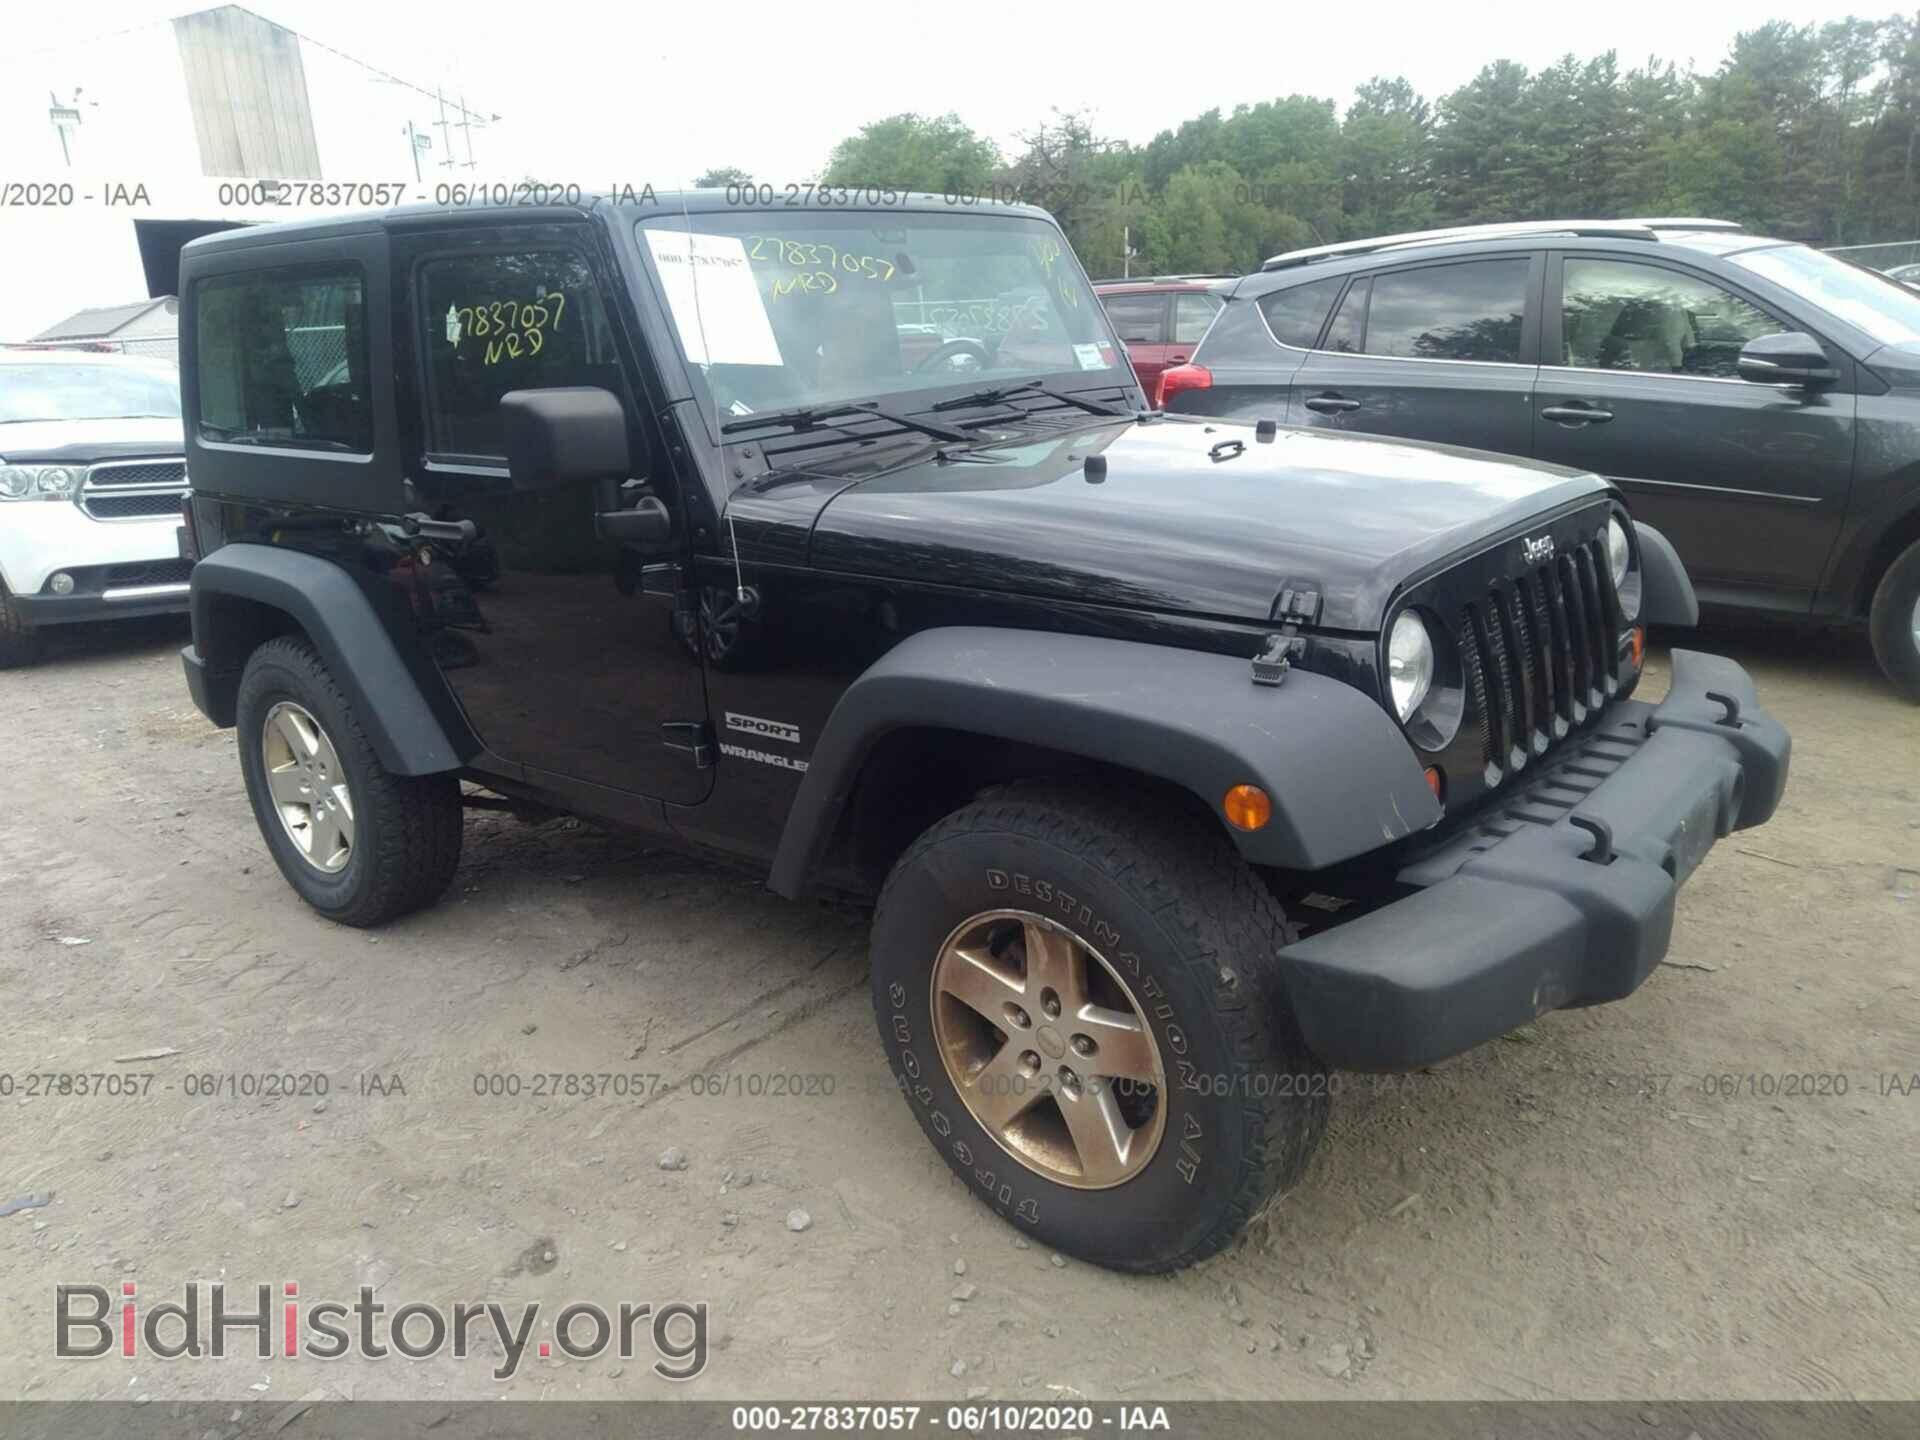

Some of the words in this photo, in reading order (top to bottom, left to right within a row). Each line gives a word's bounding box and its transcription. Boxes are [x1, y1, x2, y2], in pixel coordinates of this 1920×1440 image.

[749, 235, 896, 281] 27837057
[450, 293, 564, 338] 7837057
[484, 328, 543, 365] NRD
[728, 716, 798, 739] SPORT
[986, 869, 1200, 1091] DESTINATION
